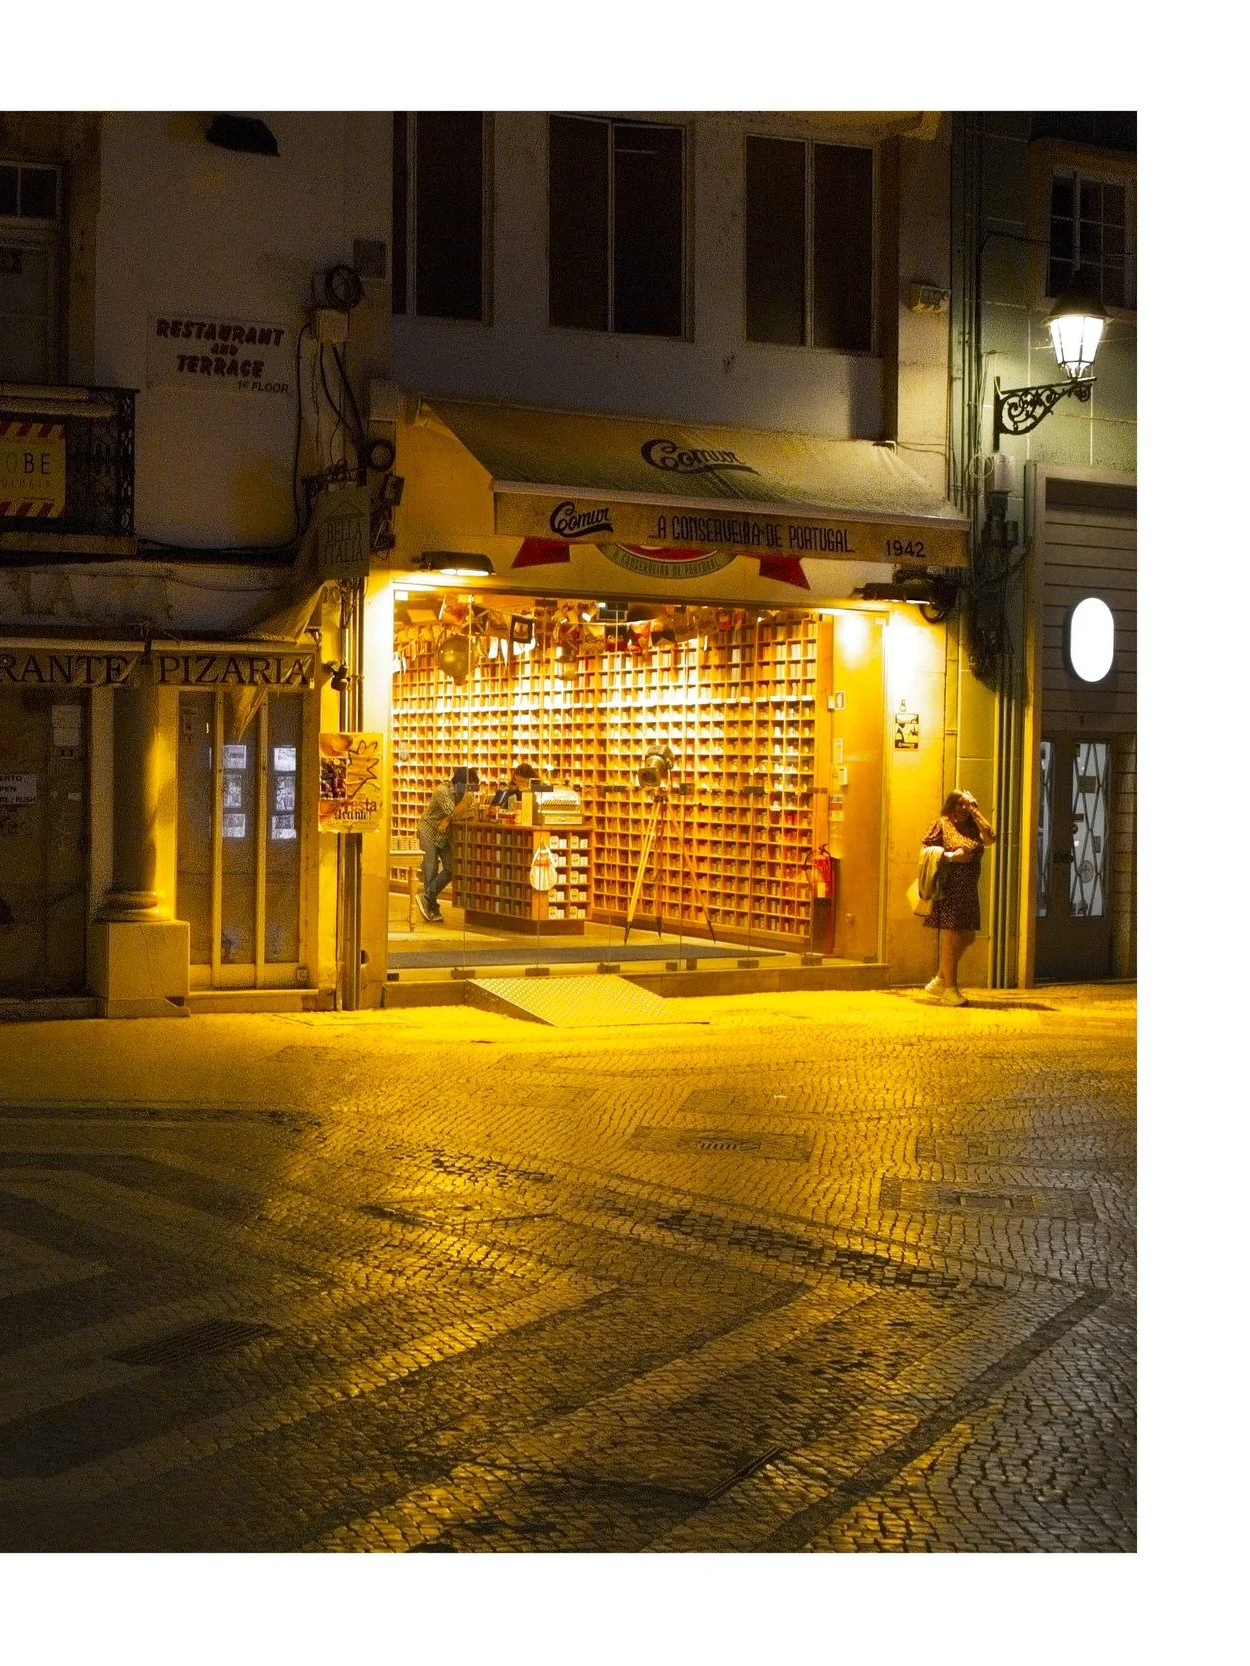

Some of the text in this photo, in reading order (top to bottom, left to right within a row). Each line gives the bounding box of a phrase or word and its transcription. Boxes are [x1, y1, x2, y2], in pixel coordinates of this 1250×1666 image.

[156, 318, 285, 346] RESTAURANT
[210, 343, 239, 356] AND
[177, 354, 264, 379] TERRACE
[251, 381, 289, 393] FLOOR
[640, 439, 761, 475] Comur
[326, 519, 362, 543] BELLA
[550, 501, 614, 539] Comur
[671, 515, 761, 546] CONSERVEIRA
[765, 524, 782, 548] DE
[324, 540, 364, 565] ITALIA
[886, 539, 926, 558] 1942
[157, 655, 309, 686] PIZARIA
